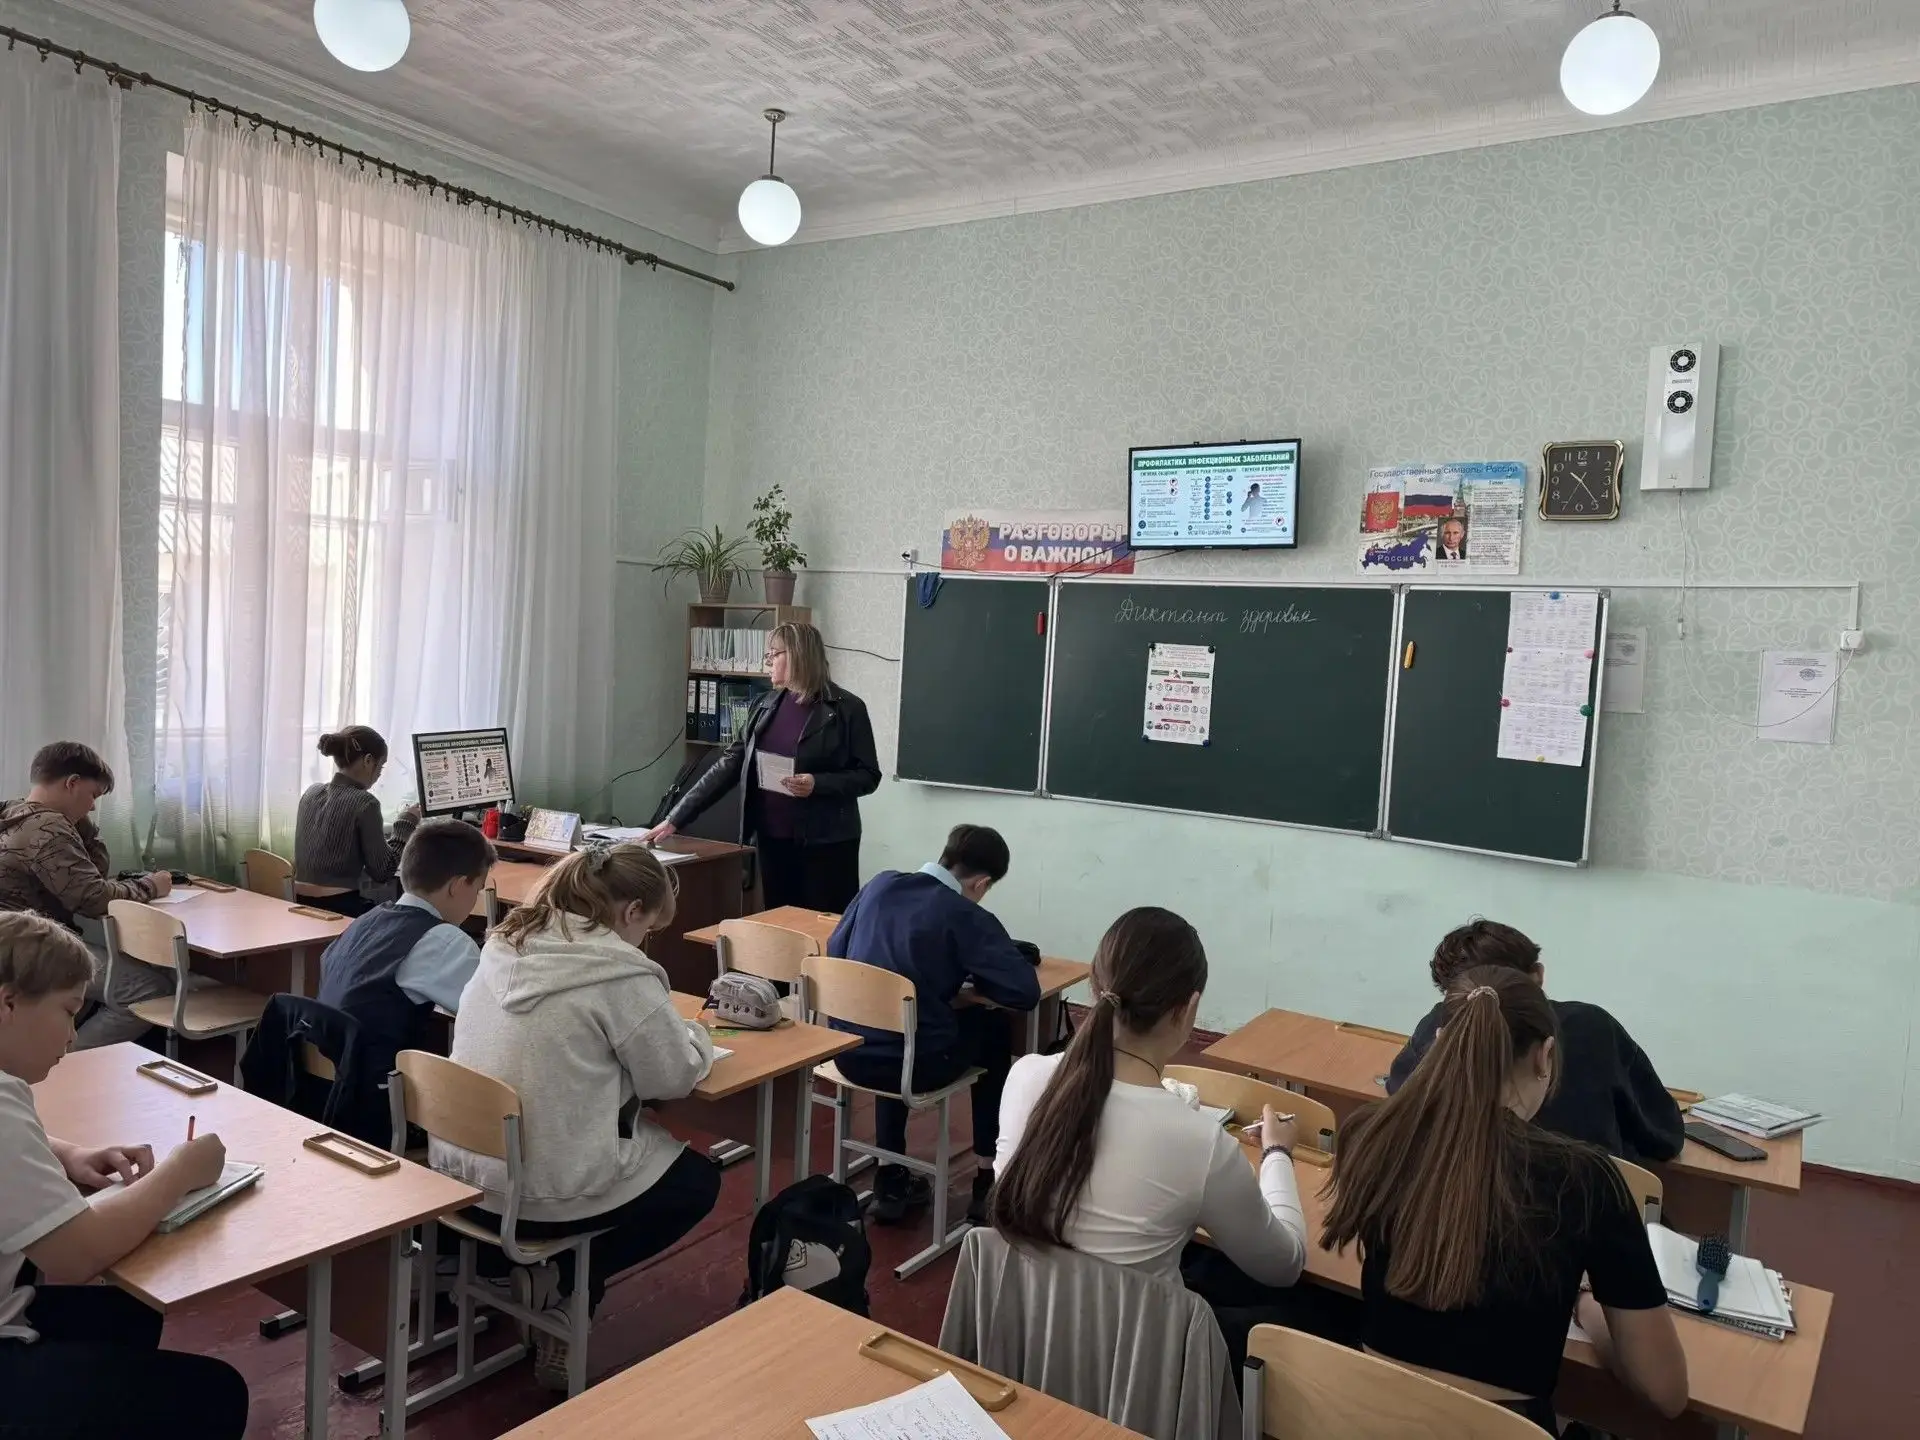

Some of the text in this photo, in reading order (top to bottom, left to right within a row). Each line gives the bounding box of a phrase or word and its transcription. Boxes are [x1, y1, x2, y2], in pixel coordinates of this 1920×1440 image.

[1138, 452, 1290, 468] ПРОФИЛАКТИКА ИНФЕКЦИОННЫХ ЗАБОЛЕВАНИЙ
[1577, 450, 1588, 461] 12
[1369, 464, 1518, 479] Государственные символы России
[1553, 462, 1565, 473] 10
[1604, 460, 1612, 472] 2
[1551, 476, 1560, 486] 9
[1603, 475, 1612, 486] 3
[1551, 490, 1560, 500] 8
[1601, 489, 1609, 500] 4
[1561, 500, 1569, 512] 7
[1574, 502, 1584, 512] 6
[998, 522, 1123, 542] РАЗГОВОРЫ
[1004, 545, 1113, 565] О ВАЖНОМ
[1377, 554, 1415, 563] Россия
[1114, 595, 1317, 634] Диктант здоровья
